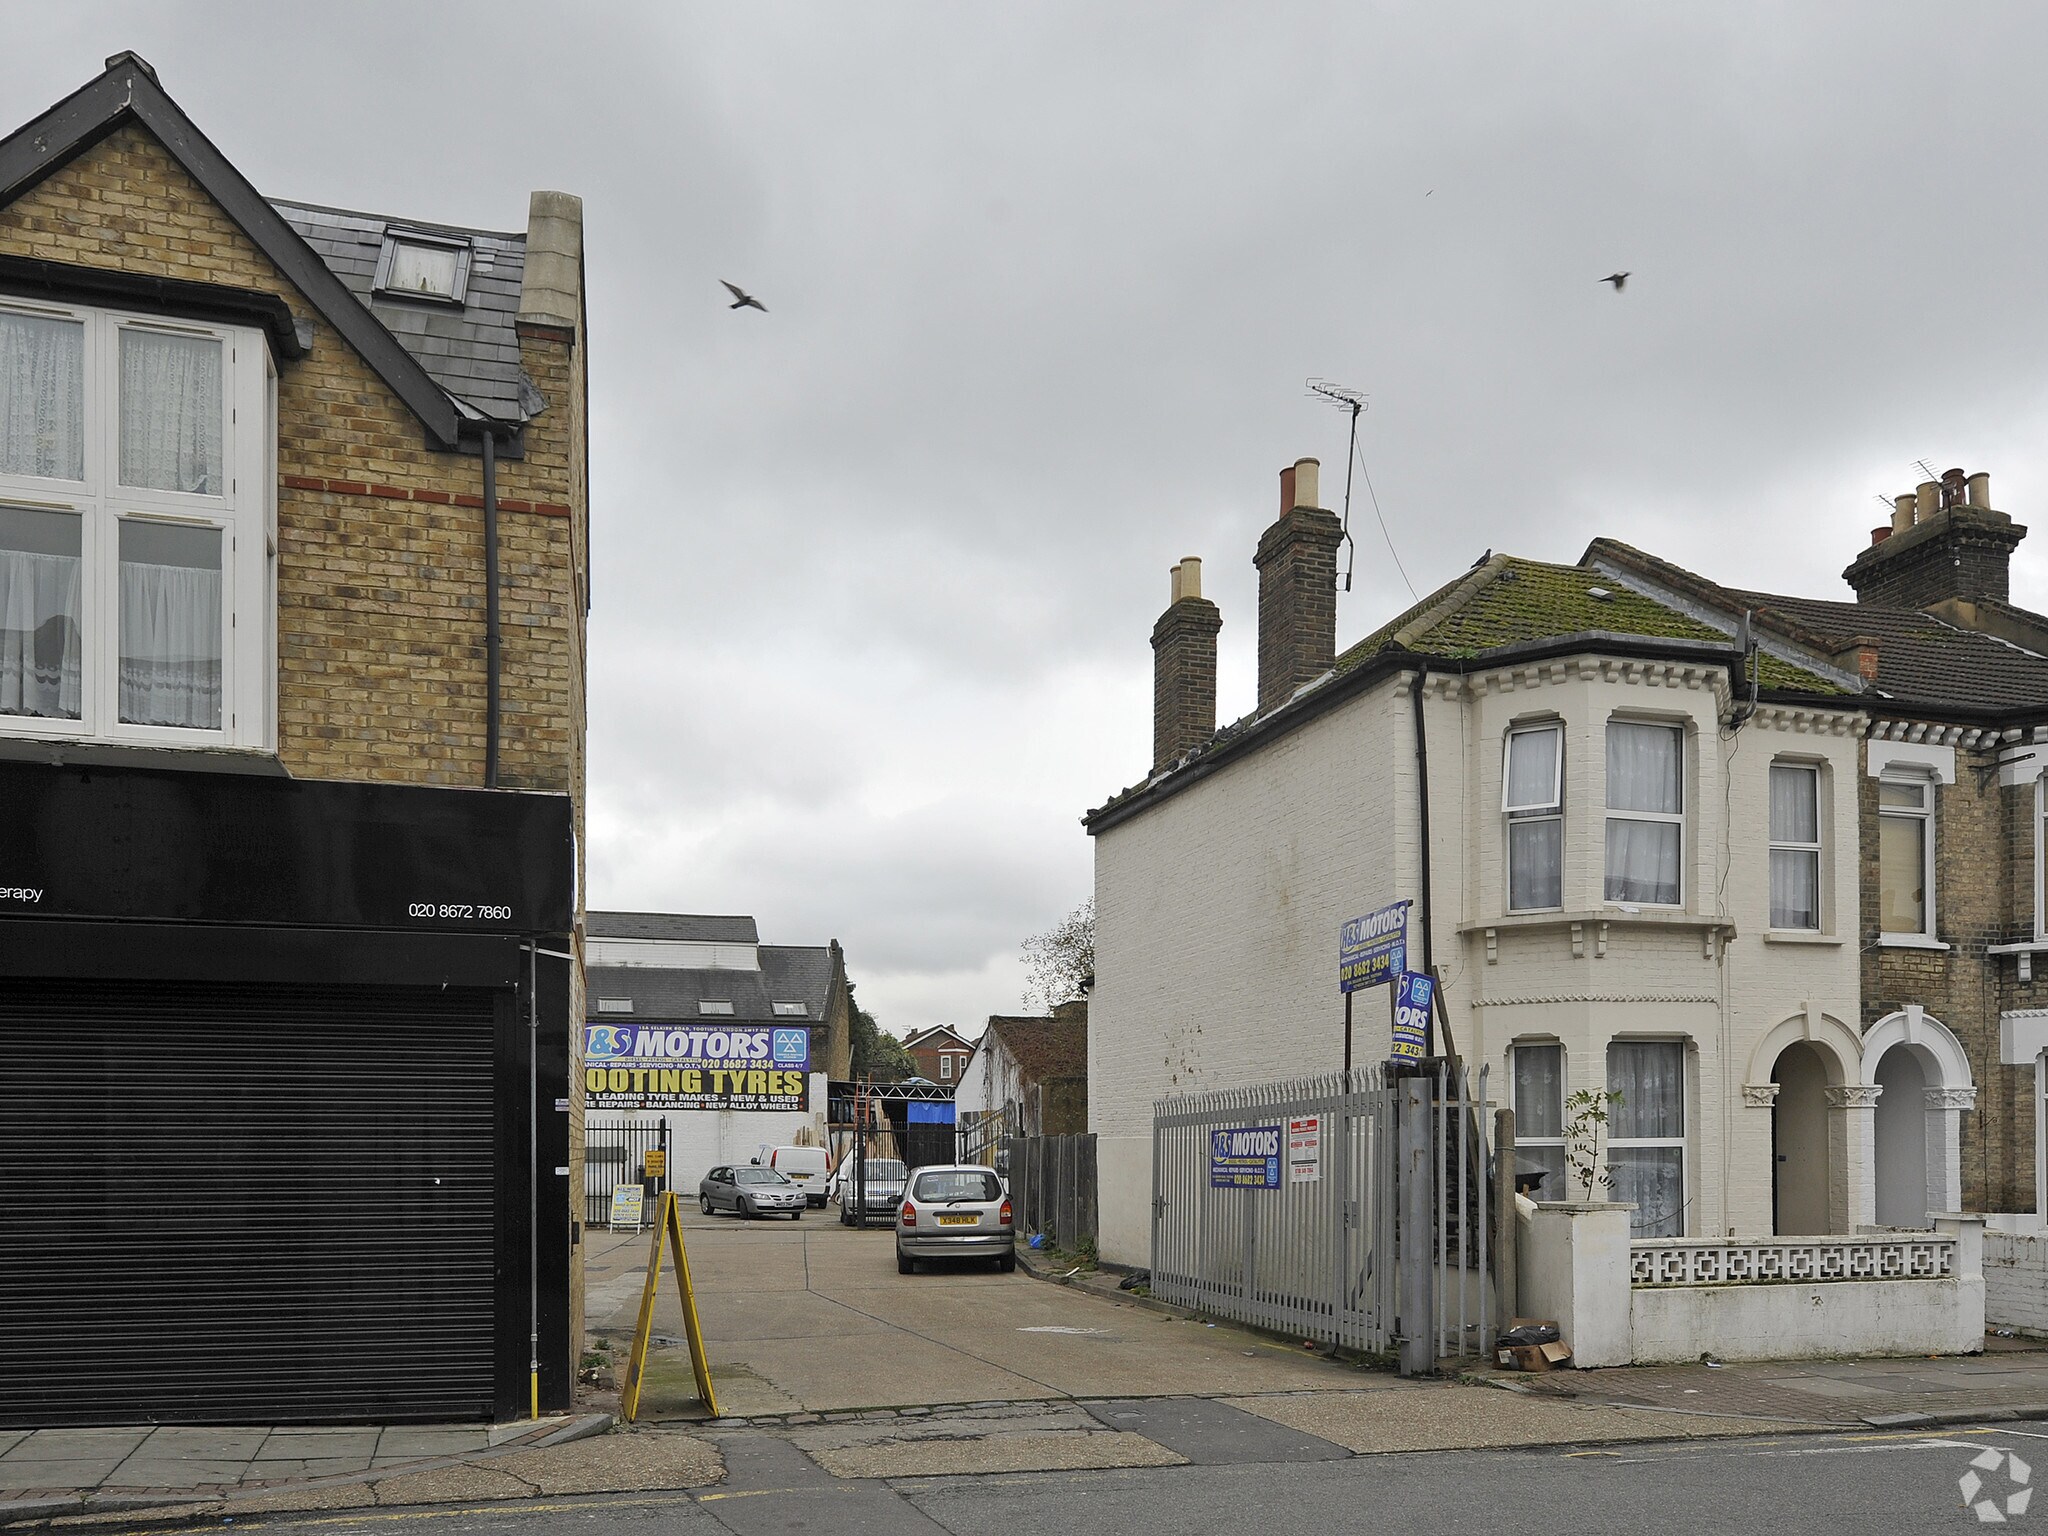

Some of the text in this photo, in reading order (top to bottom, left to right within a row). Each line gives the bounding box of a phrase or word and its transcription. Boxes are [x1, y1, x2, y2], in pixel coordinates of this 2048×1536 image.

[0, 887, 43, 903] erapy
[408, 903, 512, 919] 020 8672 7860
[1360, 906, 1405, 941] MOTORS
[1340, 965, 1353, 981] 020
[1353, 960, 1370, 977] 8682
[1371, 953, 1390, 972] 3434
[1396, 1006, 1428, 1029] ORS
[633, 1031, 769, 1059] MOTORS
[1404, 1044, 1423, 1056] 343
[701, 1059, 774, 1070] 020 8682 3434
[709, 1070, 803, 1095] TYRES
[596, 1093, 644, 1101] LEADING
[770, 1095, 799, 1103] USED
[1232, 1131, 1278, 1155] MOTORS
[1242, 1174, 1253, 1185] 8682
[1254, 1175, 1265, 1185] 3434
